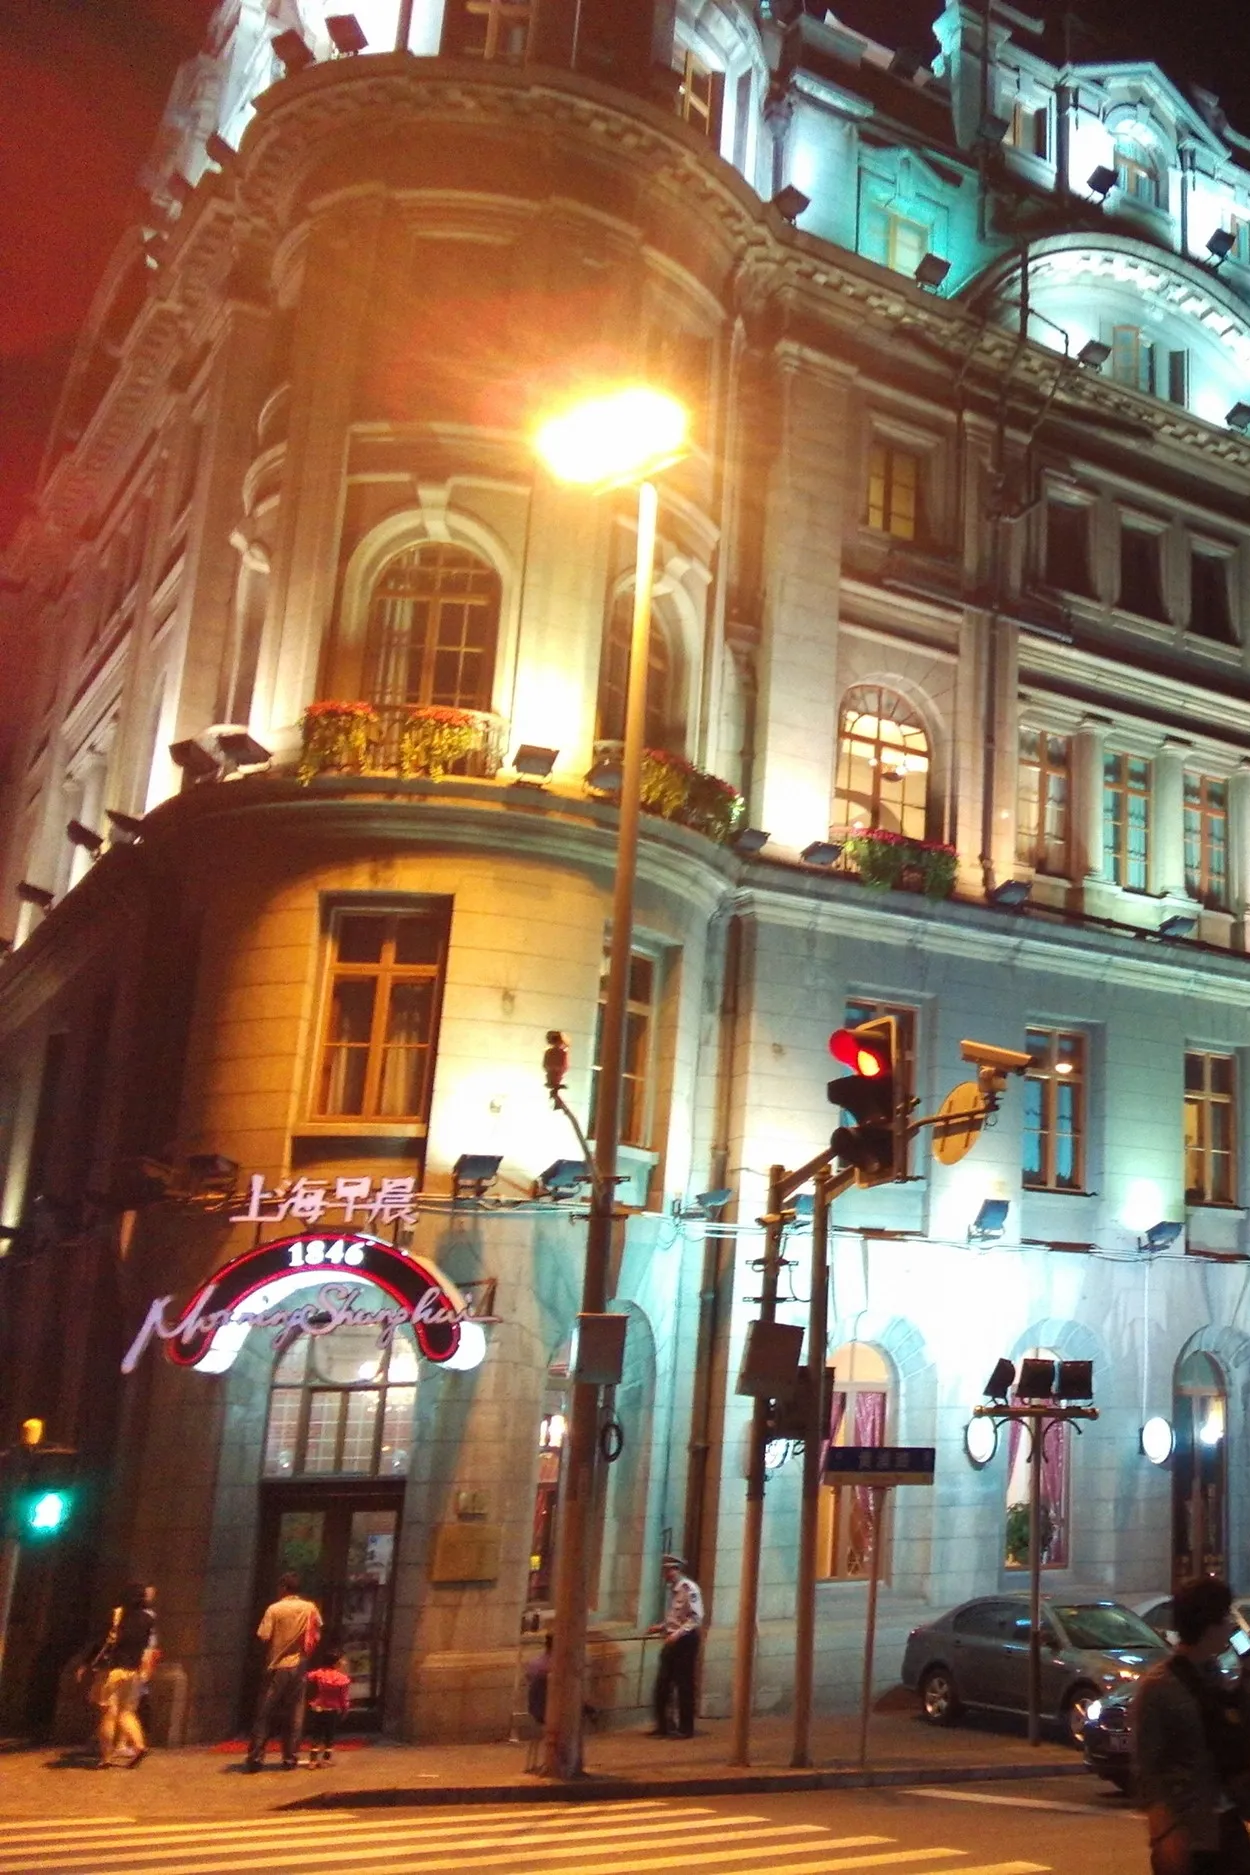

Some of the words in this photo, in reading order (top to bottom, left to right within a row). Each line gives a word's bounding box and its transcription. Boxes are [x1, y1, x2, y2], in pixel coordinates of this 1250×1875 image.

[229, 1173, 420, 1226] 上海早晨
[287, 1240, 365, 1267] 1846
